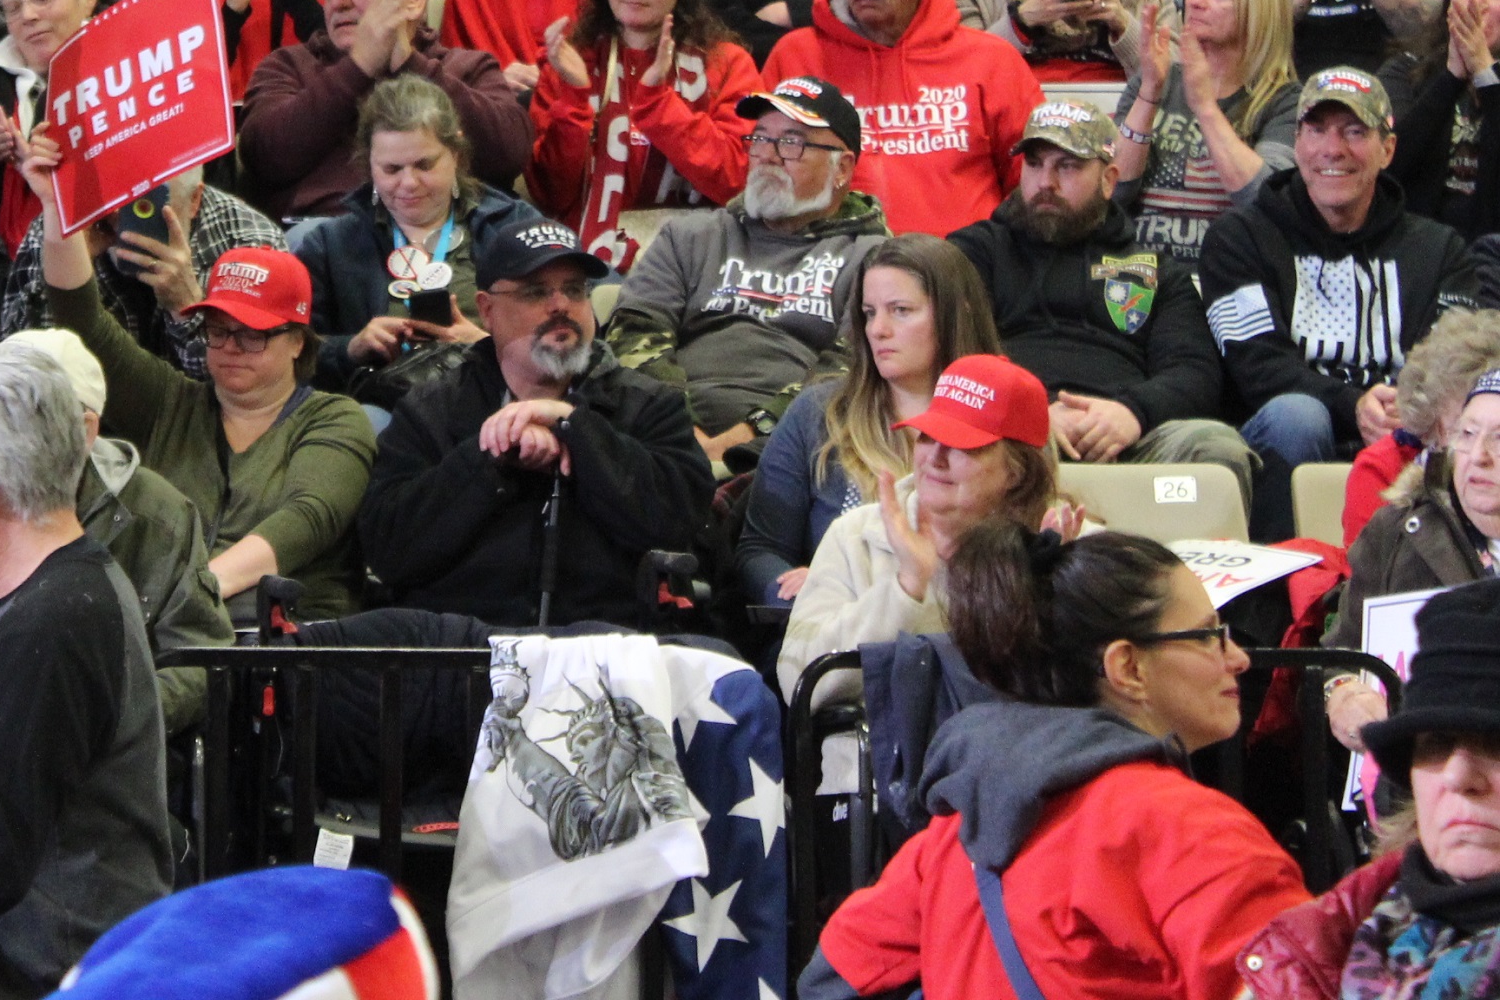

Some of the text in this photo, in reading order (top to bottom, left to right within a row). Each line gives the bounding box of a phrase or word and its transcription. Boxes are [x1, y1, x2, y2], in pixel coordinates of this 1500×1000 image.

[53, 24, 206, 127] TRUMP
[919, 85, 967, 106] 2020
[69, 69, 196, 148] PENCE
[1034, 101, 1091, 124] TRUMP
[104, 117, 149, 152] AMERICA
[148, 102, 184, 132] GREAT!
[1041, 117, 1071, 129] 2020
[860, 130, 969, 160] President
[515, 226, 576, 243] TRUMP
[216, 262, 269, 286] Trump
[222, 276, 252, 290] 2020
[720, 257, 841, 299] Trump
[949, 390, 986, 411] AGAIN
[951, 378, 996, 402] AMERICA
[1163, 480, 1189, 499] 26
